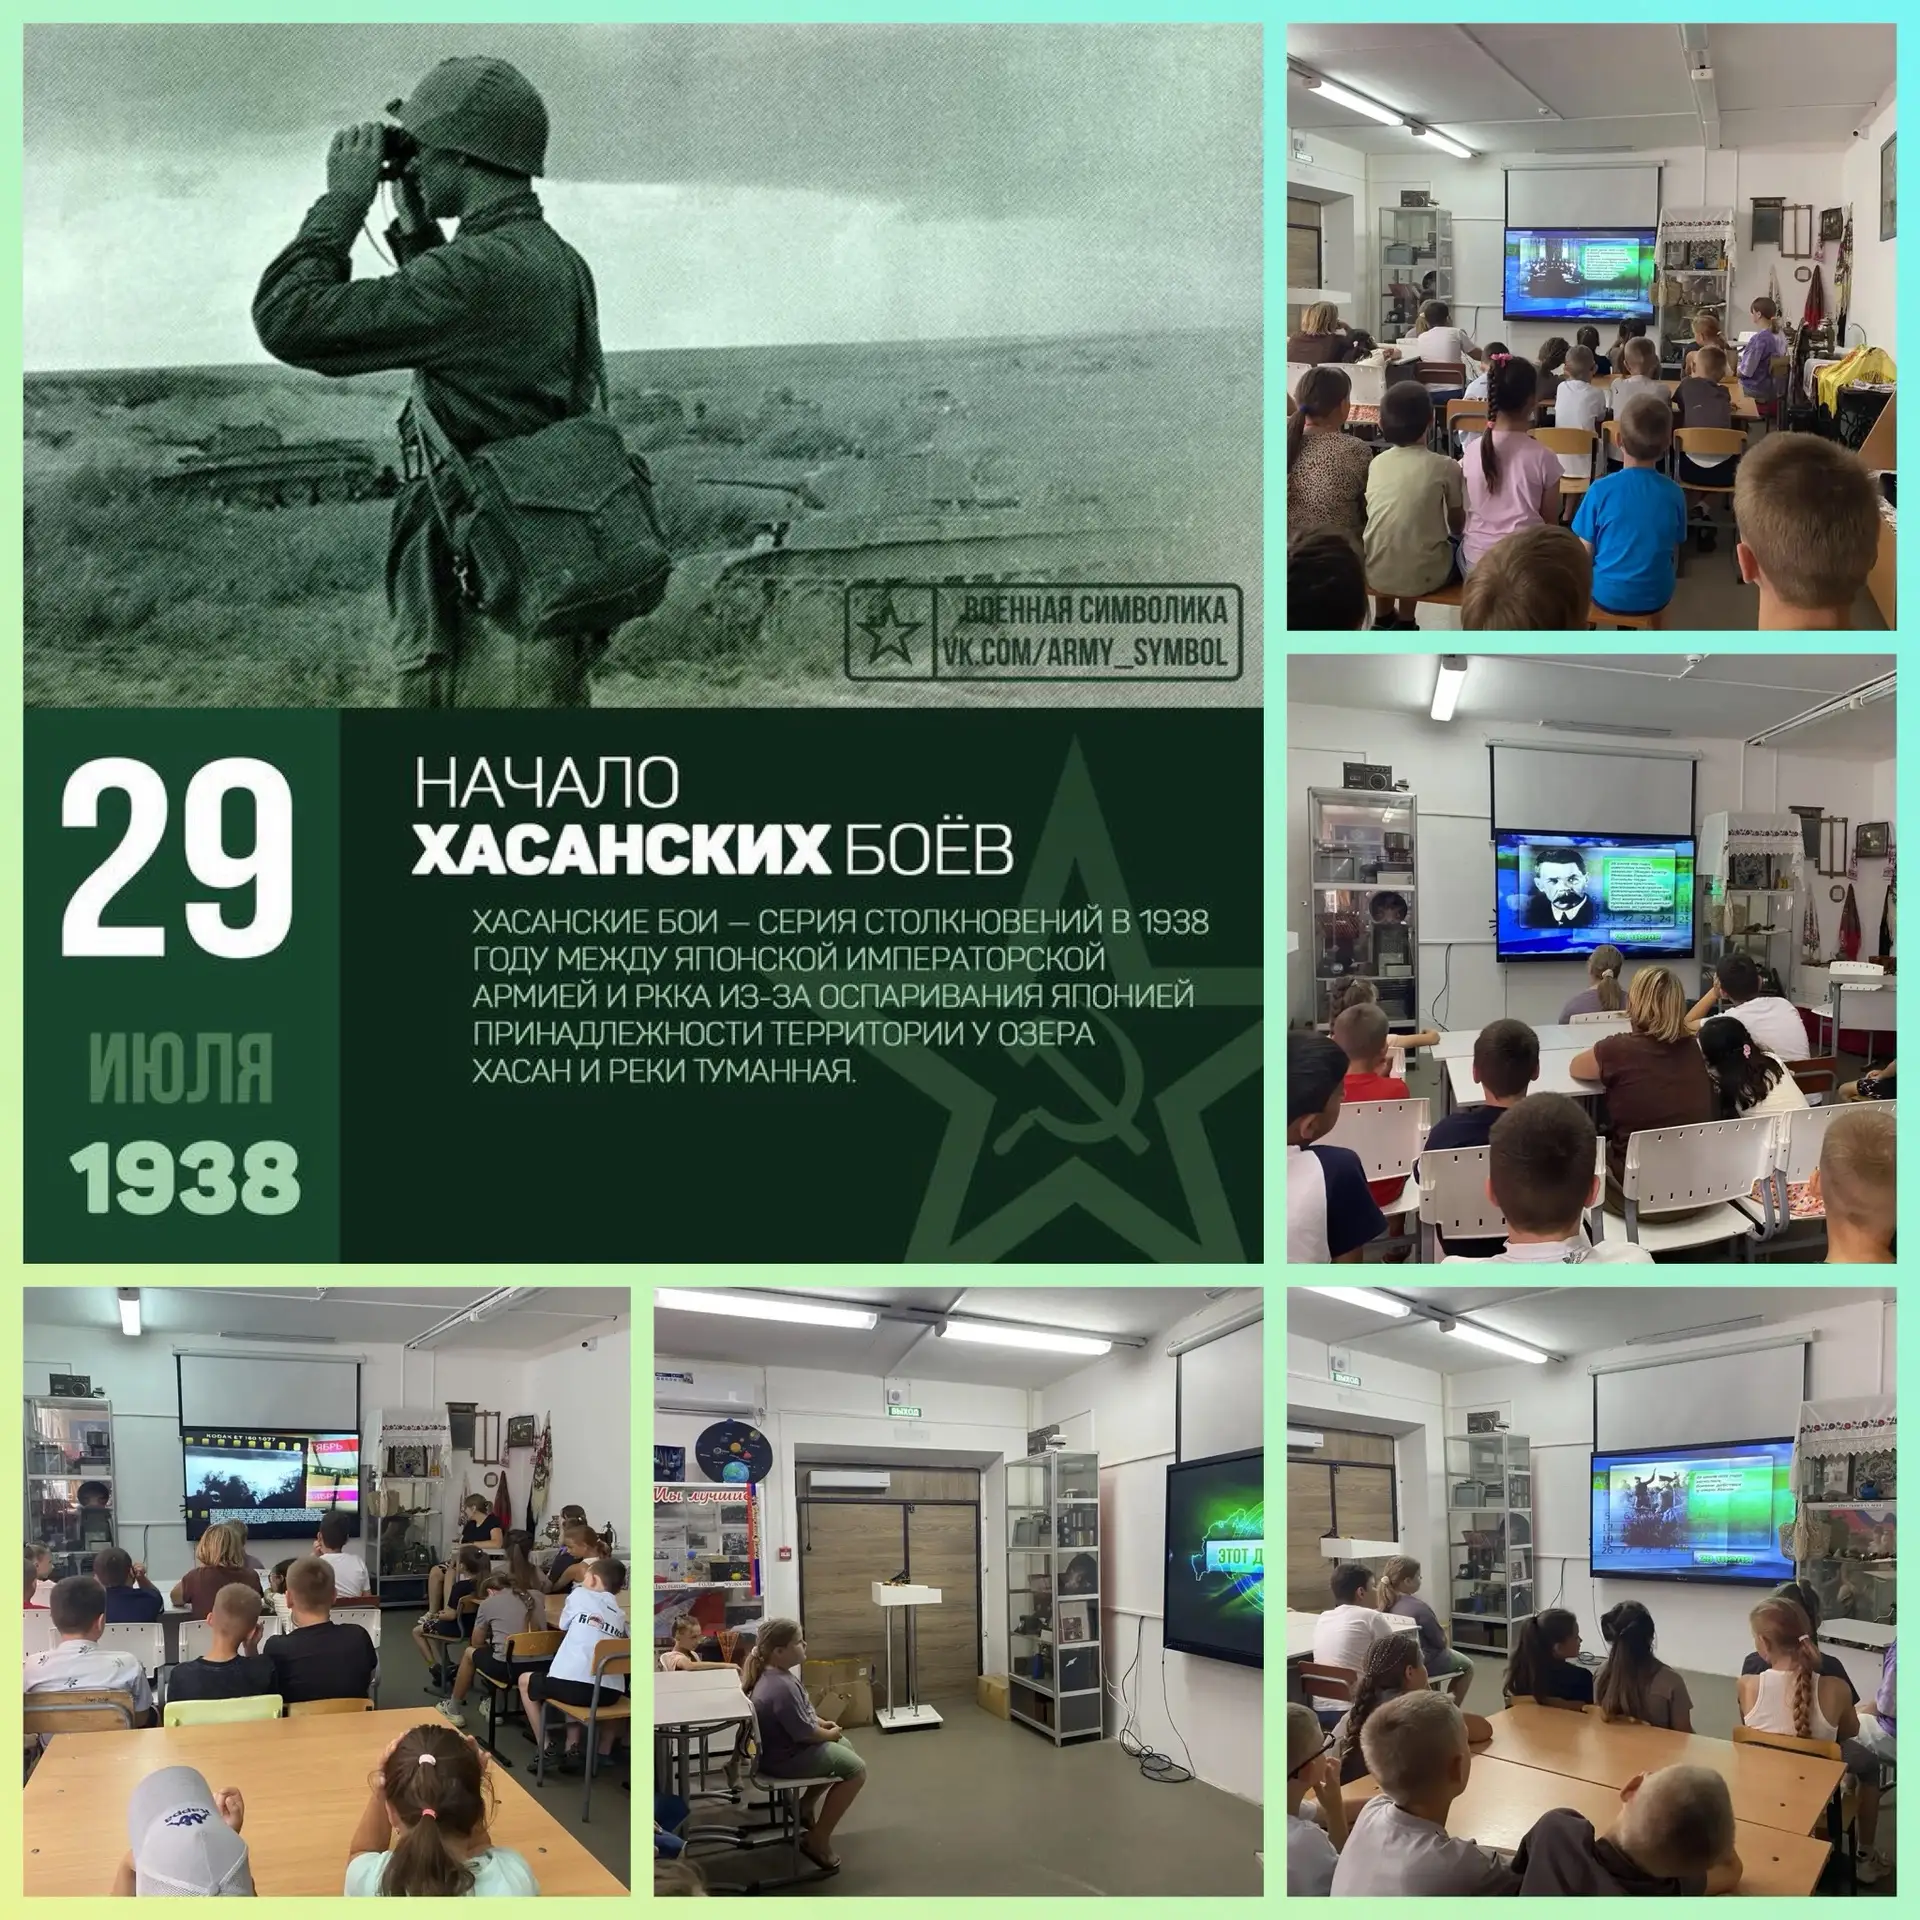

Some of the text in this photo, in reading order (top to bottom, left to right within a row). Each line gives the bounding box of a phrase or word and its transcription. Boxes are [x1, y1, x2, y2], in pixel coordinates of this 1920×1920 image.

[416, 756, 679, 809] НАЧАЛО
[62, 757, 292, 958] 29
[412, 814, 1014, 876] ХАСАНСКИХ БОЁВ
[472, 909, 649, 935] ХАСАНСКИЕ
[658, 909, 718, 935] БОИ
[759, 909, 856, 935] СЕРИЯ
[865, 903, 1103, 935] СТОЛКНОВЕНИЙ
[1112, 909, 1131, 934] В
[1139, 909, 1210, 935] 1938
[1640, 915, 1652, 923] 23
[1660, 915, 1671, 924] 24
[474, 940, 1105, 976] ГОДУ МЕЖДУ ЯПОНСКОЙ ИМПЕРАТОРСКОЙ
[472, 978, 1194, 1010] АРМИЕЙ И РККА ИЗ-ЗА ОСПАРИВАНИЯ ЯПОНИЕЙ
[474, 1021, 1096, 1050] ПРИНАДЛЕЖНОСТИ ТЕРРИТОРИИ У ОЗЕРА
[89, 1032, 273, 1105] ИЮЛЯ
[472, 1058, 857, 1083] ХАСАН И РЕКИ ТУМАННАЯ.
[69, 1140, 301, 1216] 1938
[891, 1407, 920, 1417] ВЫХОД
[1218, 1548, 1249, 1564] ЭТОТ
